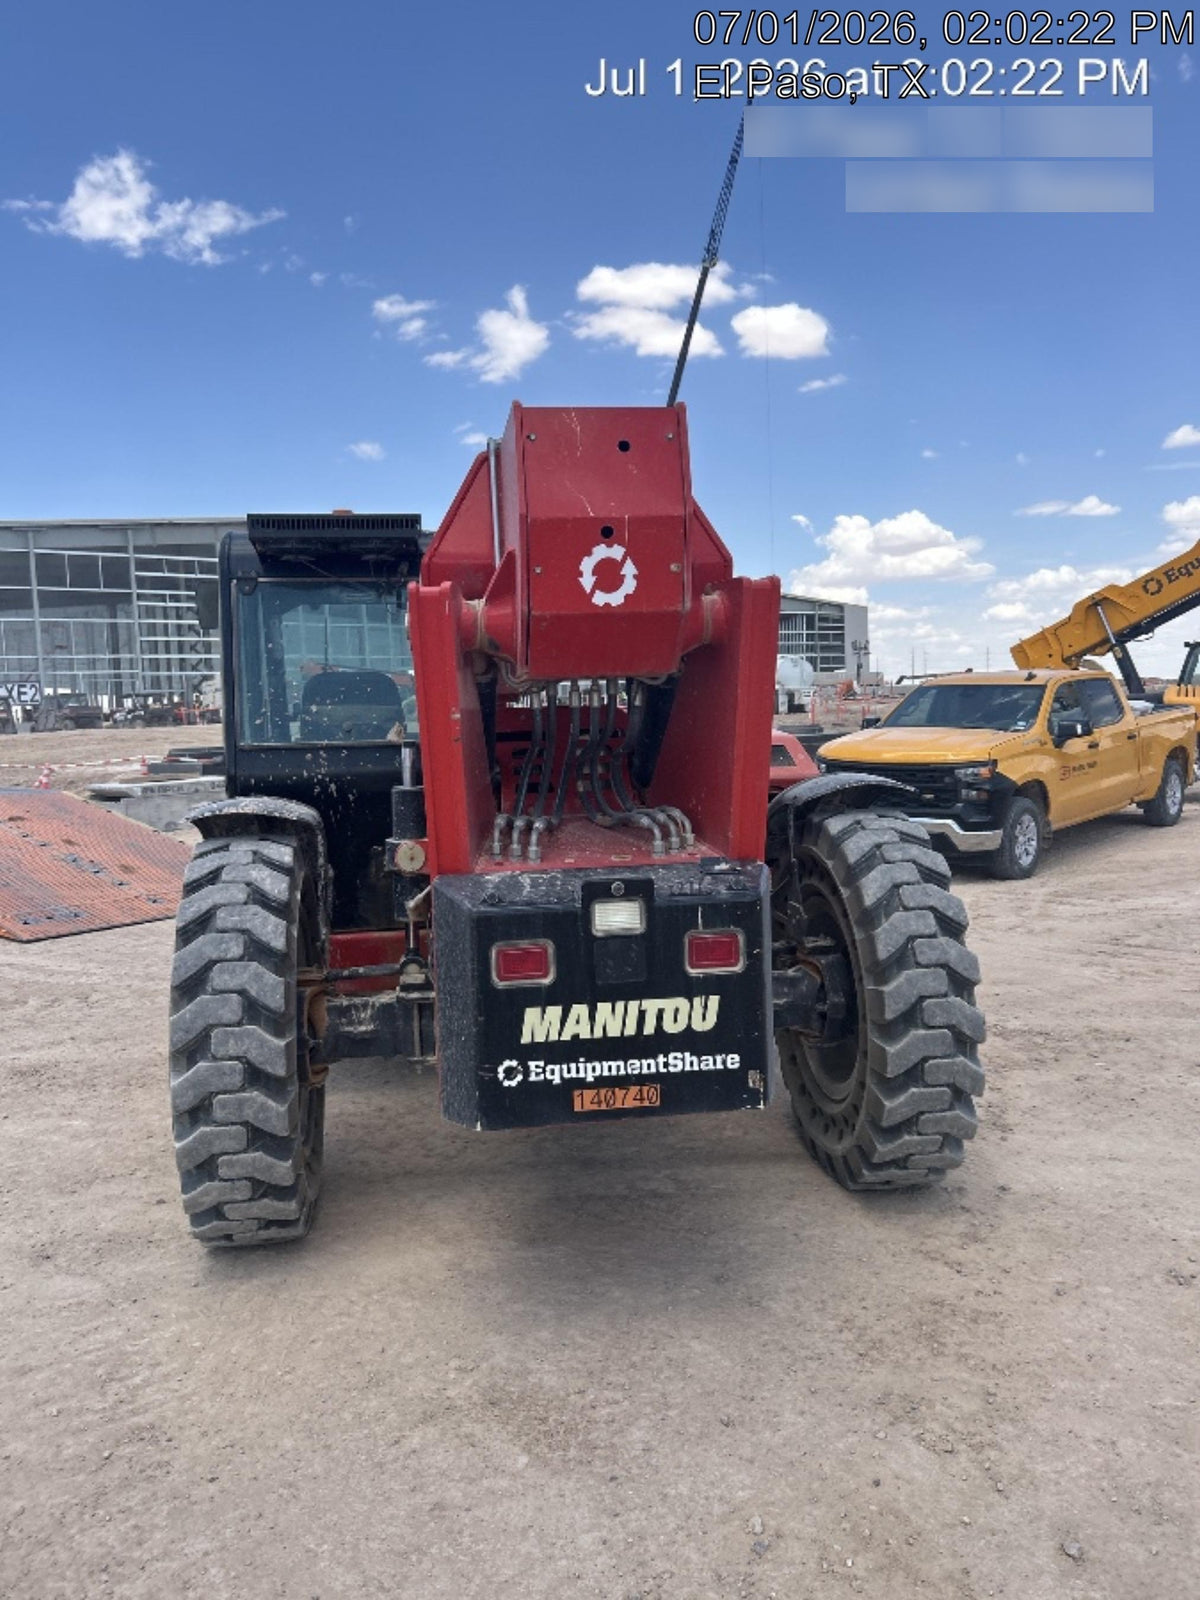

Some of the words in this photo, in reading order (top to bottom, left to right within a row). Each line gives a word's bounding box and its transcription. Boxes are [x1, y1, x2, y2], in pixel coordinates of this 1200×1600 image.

[0, 683, 40, 703] XE2
[521, 995, 720, 1044] MANITOU
[527, 1052, 741, 1084] EquipmentShare
[577, 1086, 659, 1110] 140740
